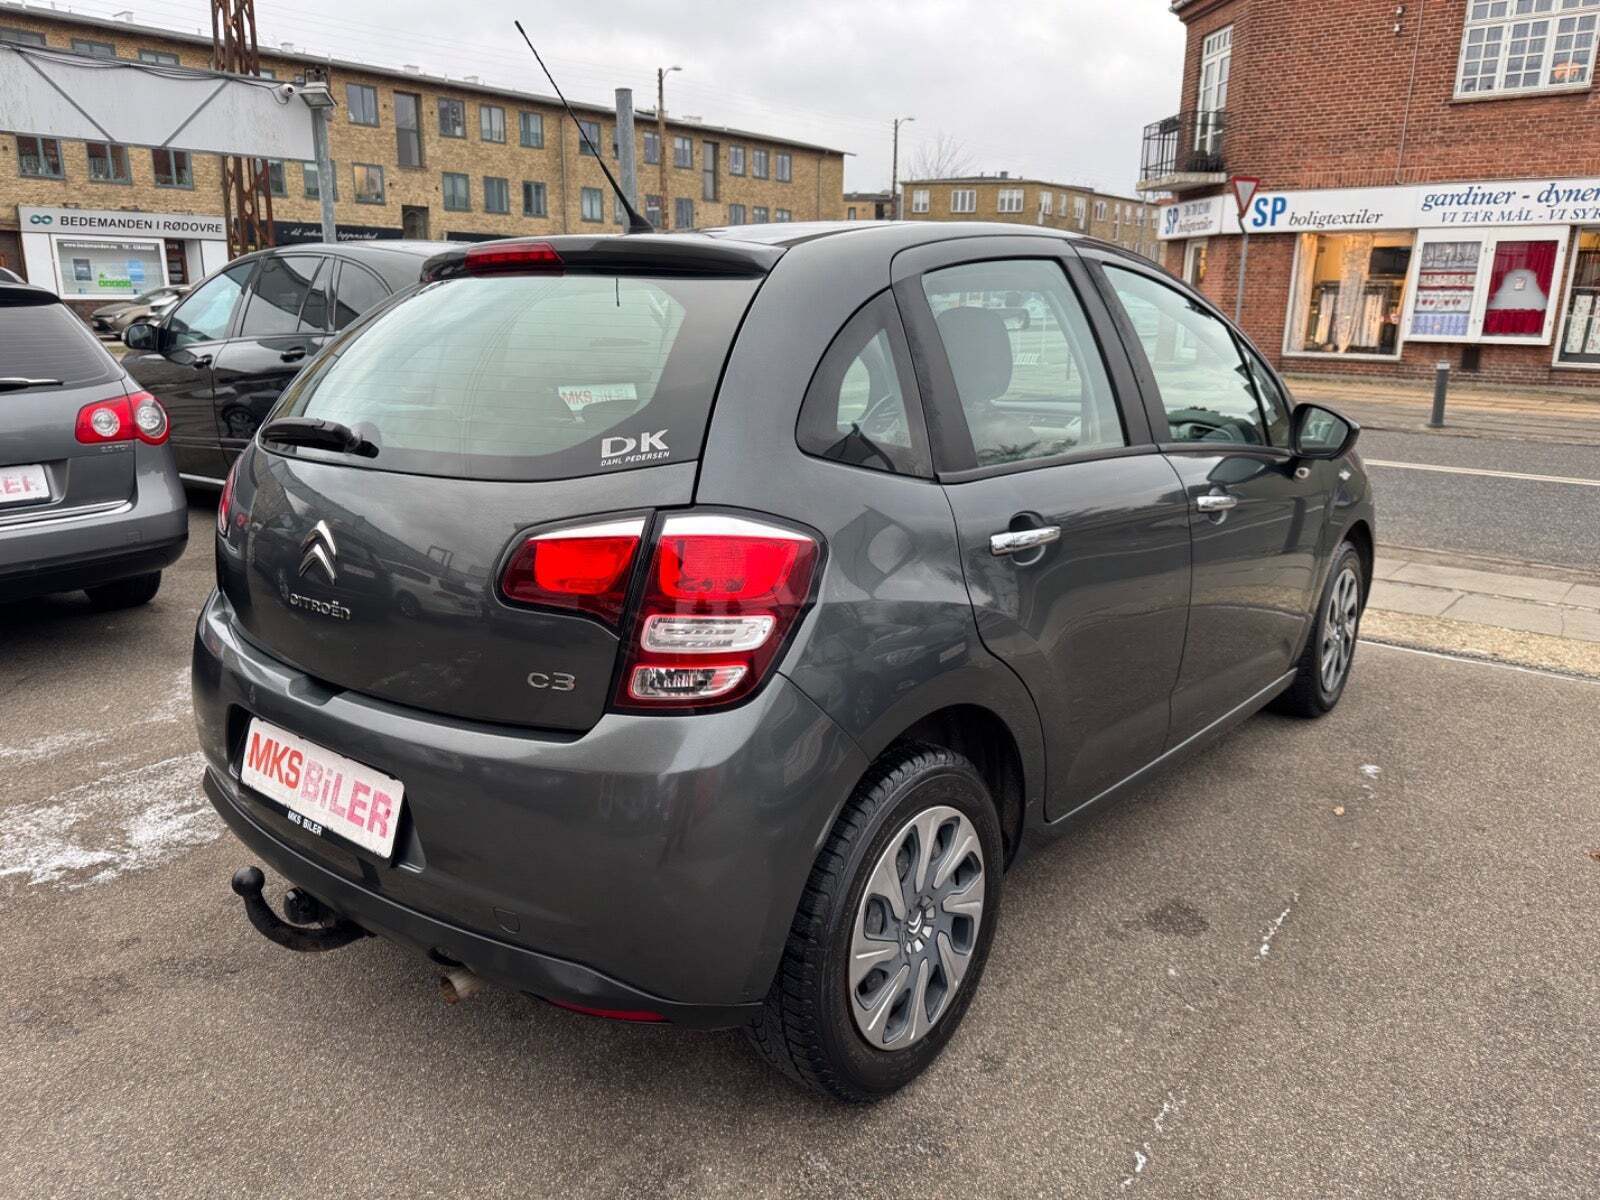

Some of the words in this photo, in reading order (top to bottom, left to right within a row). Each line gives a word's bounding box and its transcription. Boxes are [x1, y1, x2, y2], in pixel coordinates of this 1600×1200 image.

[1421, 185, 1516, 211] gardiner
[60, 215, 152, 230] BEDEMANDEN
[156, 221, 160, 230] I
[163, 221, 223, 233] RØDOVRE
[1165, 207, 1179, 234] SP
[1252, 197, 1287, 227] SP
[1289, 209, 1384, 229] boligtextiler
[1441, 212, 1457, 223] VI
[1461, 209, 1494, 222] TA'R
[1497, 206, 1533, 221] MÅL
[1549, 209, 1567, 220] VI
[601, 429, 669, 458] DK
[601, 458, 623, 466] DAHL
[625, 451, 670, 462] PEDERSEN
[290, 593, 351, 620] CITROËN
[527, 672, 576, 691] C3
[287, 810, 302, 825] MKS
